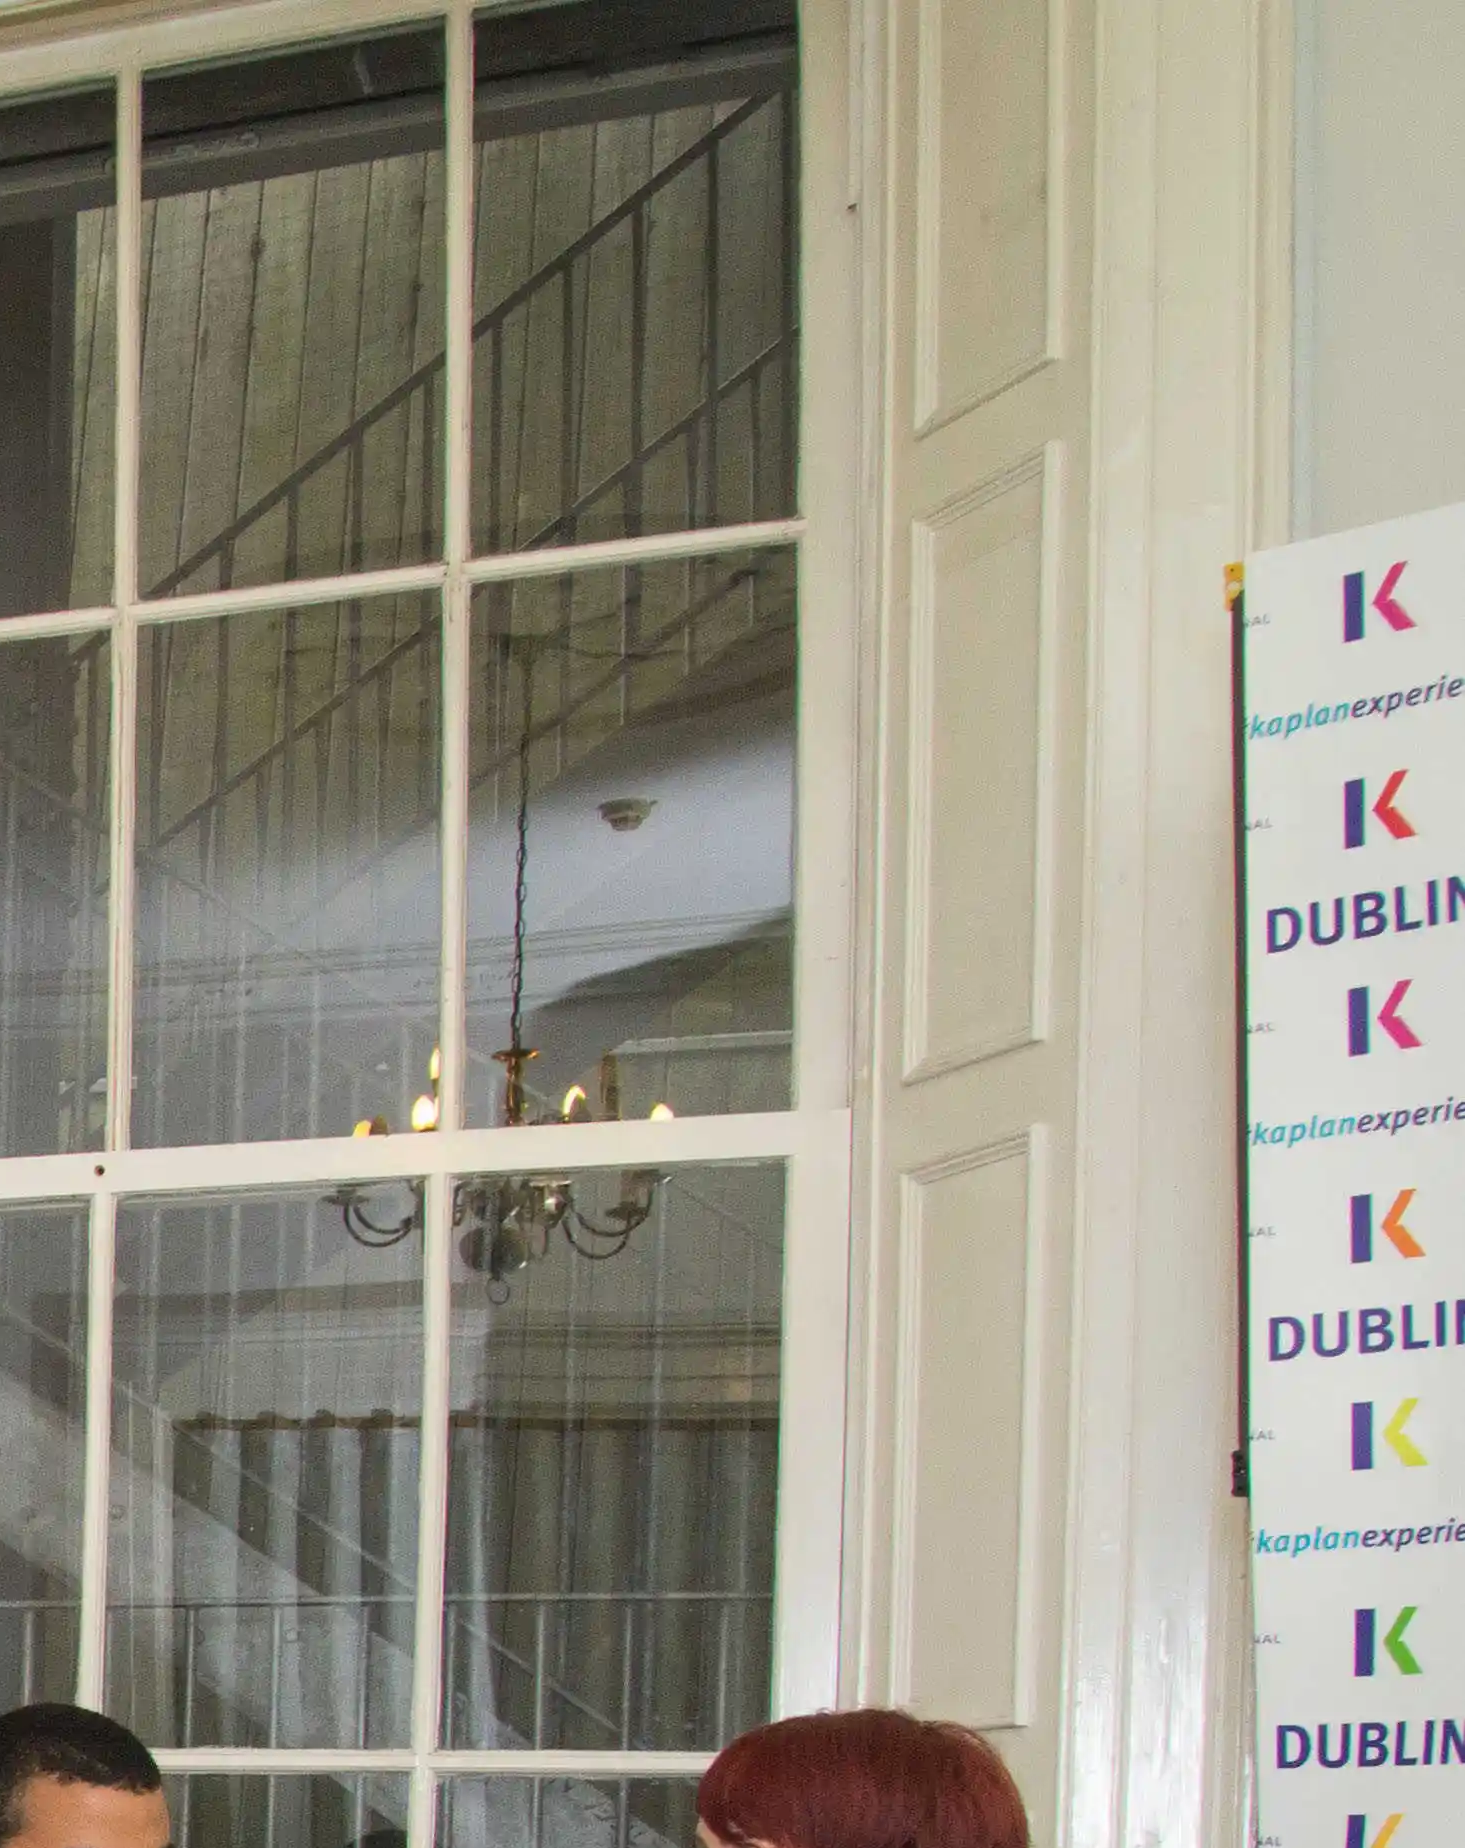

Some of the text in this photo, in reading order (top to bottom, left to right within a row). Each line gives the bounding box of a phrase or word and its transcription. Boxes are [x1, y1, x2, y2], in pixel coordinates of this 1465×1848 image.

[1342, 560, 1418, 643] K
[1343, 768, 1418, 850] K
[1347, 978, 1424, 1057] K
[1350, 1188, 1426, 1264] K
[1268, 1299, 1465, 1361] DUBLI
[1350, 1398, 1429, 1471] K
[1353, 1606, 1423, 1677] K
[1276, 1718, 1465, 1770] DUBLIN
